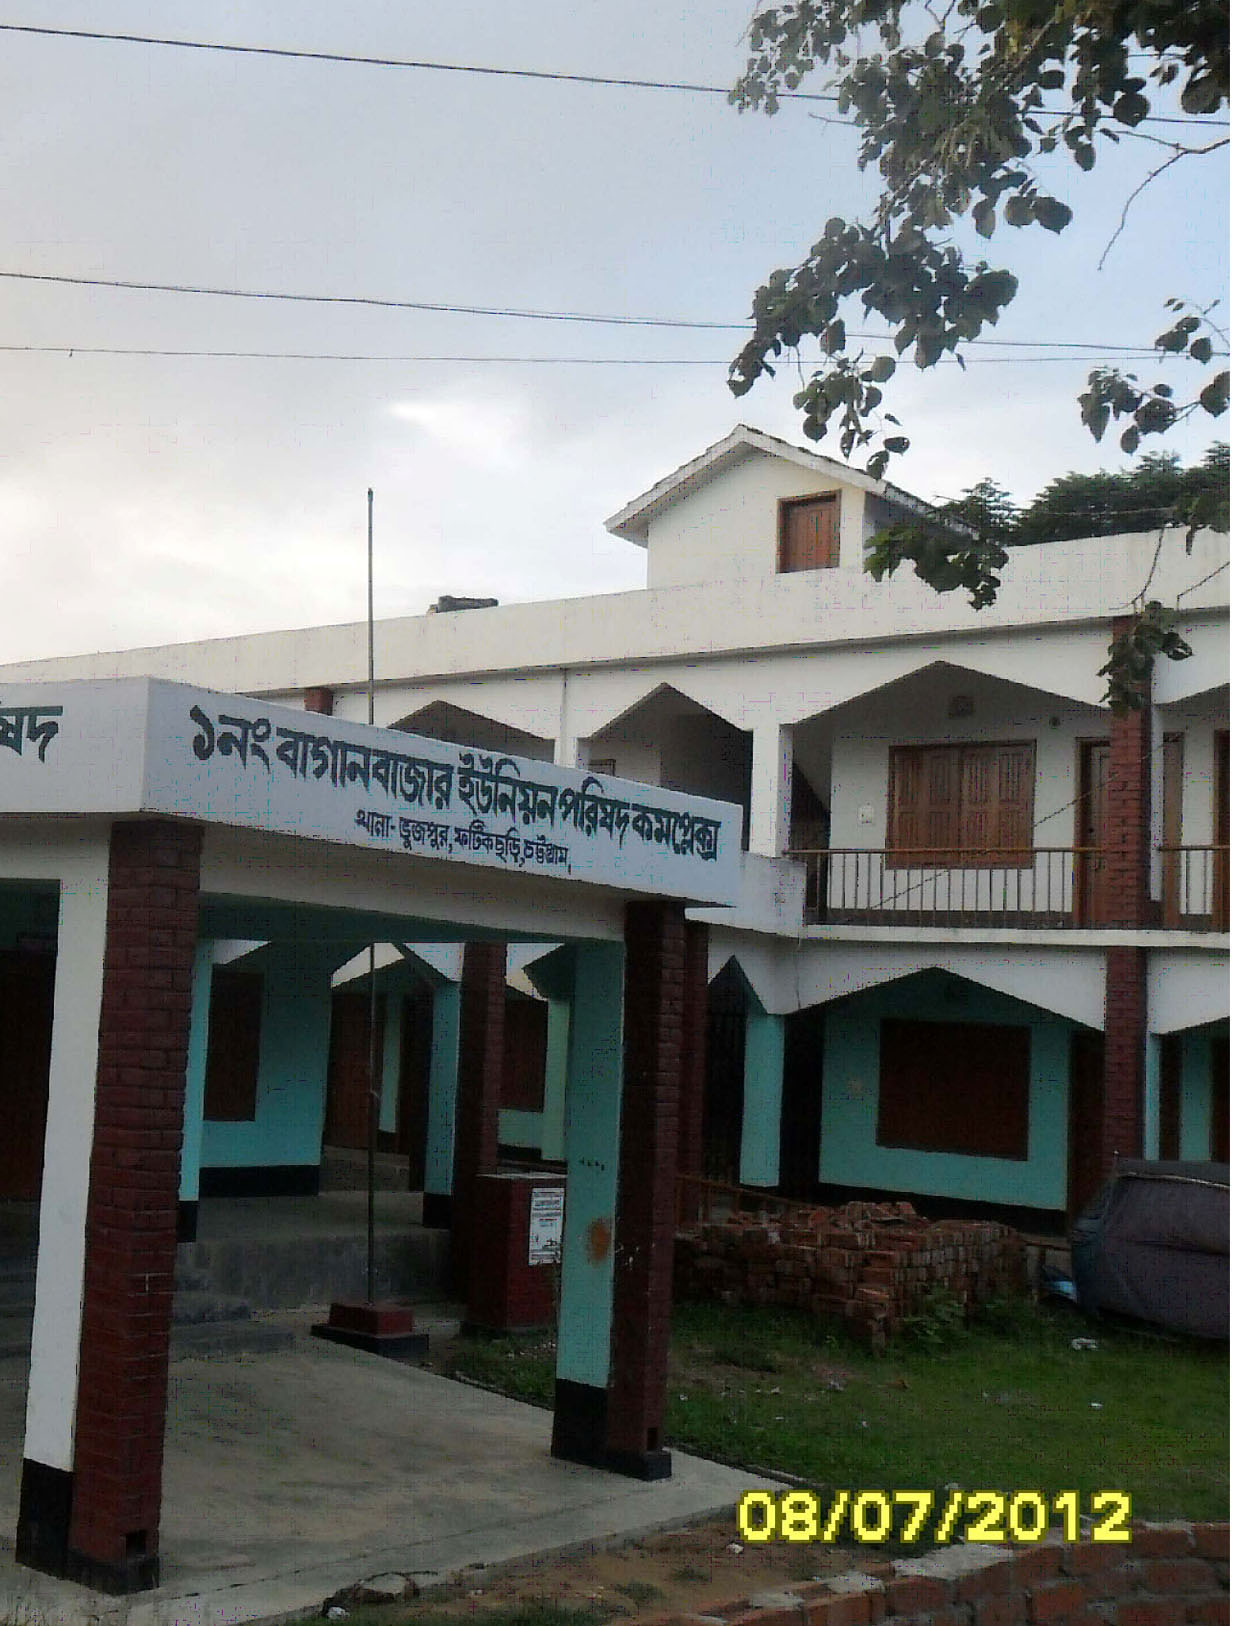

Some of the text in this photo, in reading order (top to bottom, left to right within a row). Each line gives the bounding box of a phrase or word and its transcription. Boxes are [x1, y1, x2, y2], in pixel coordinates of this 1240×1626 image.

[189, 704, 272, 775] ১নং
[457, 752, 559, 831] ইউনিয়ন
[560, 776, 631, 850] পরিষদ
